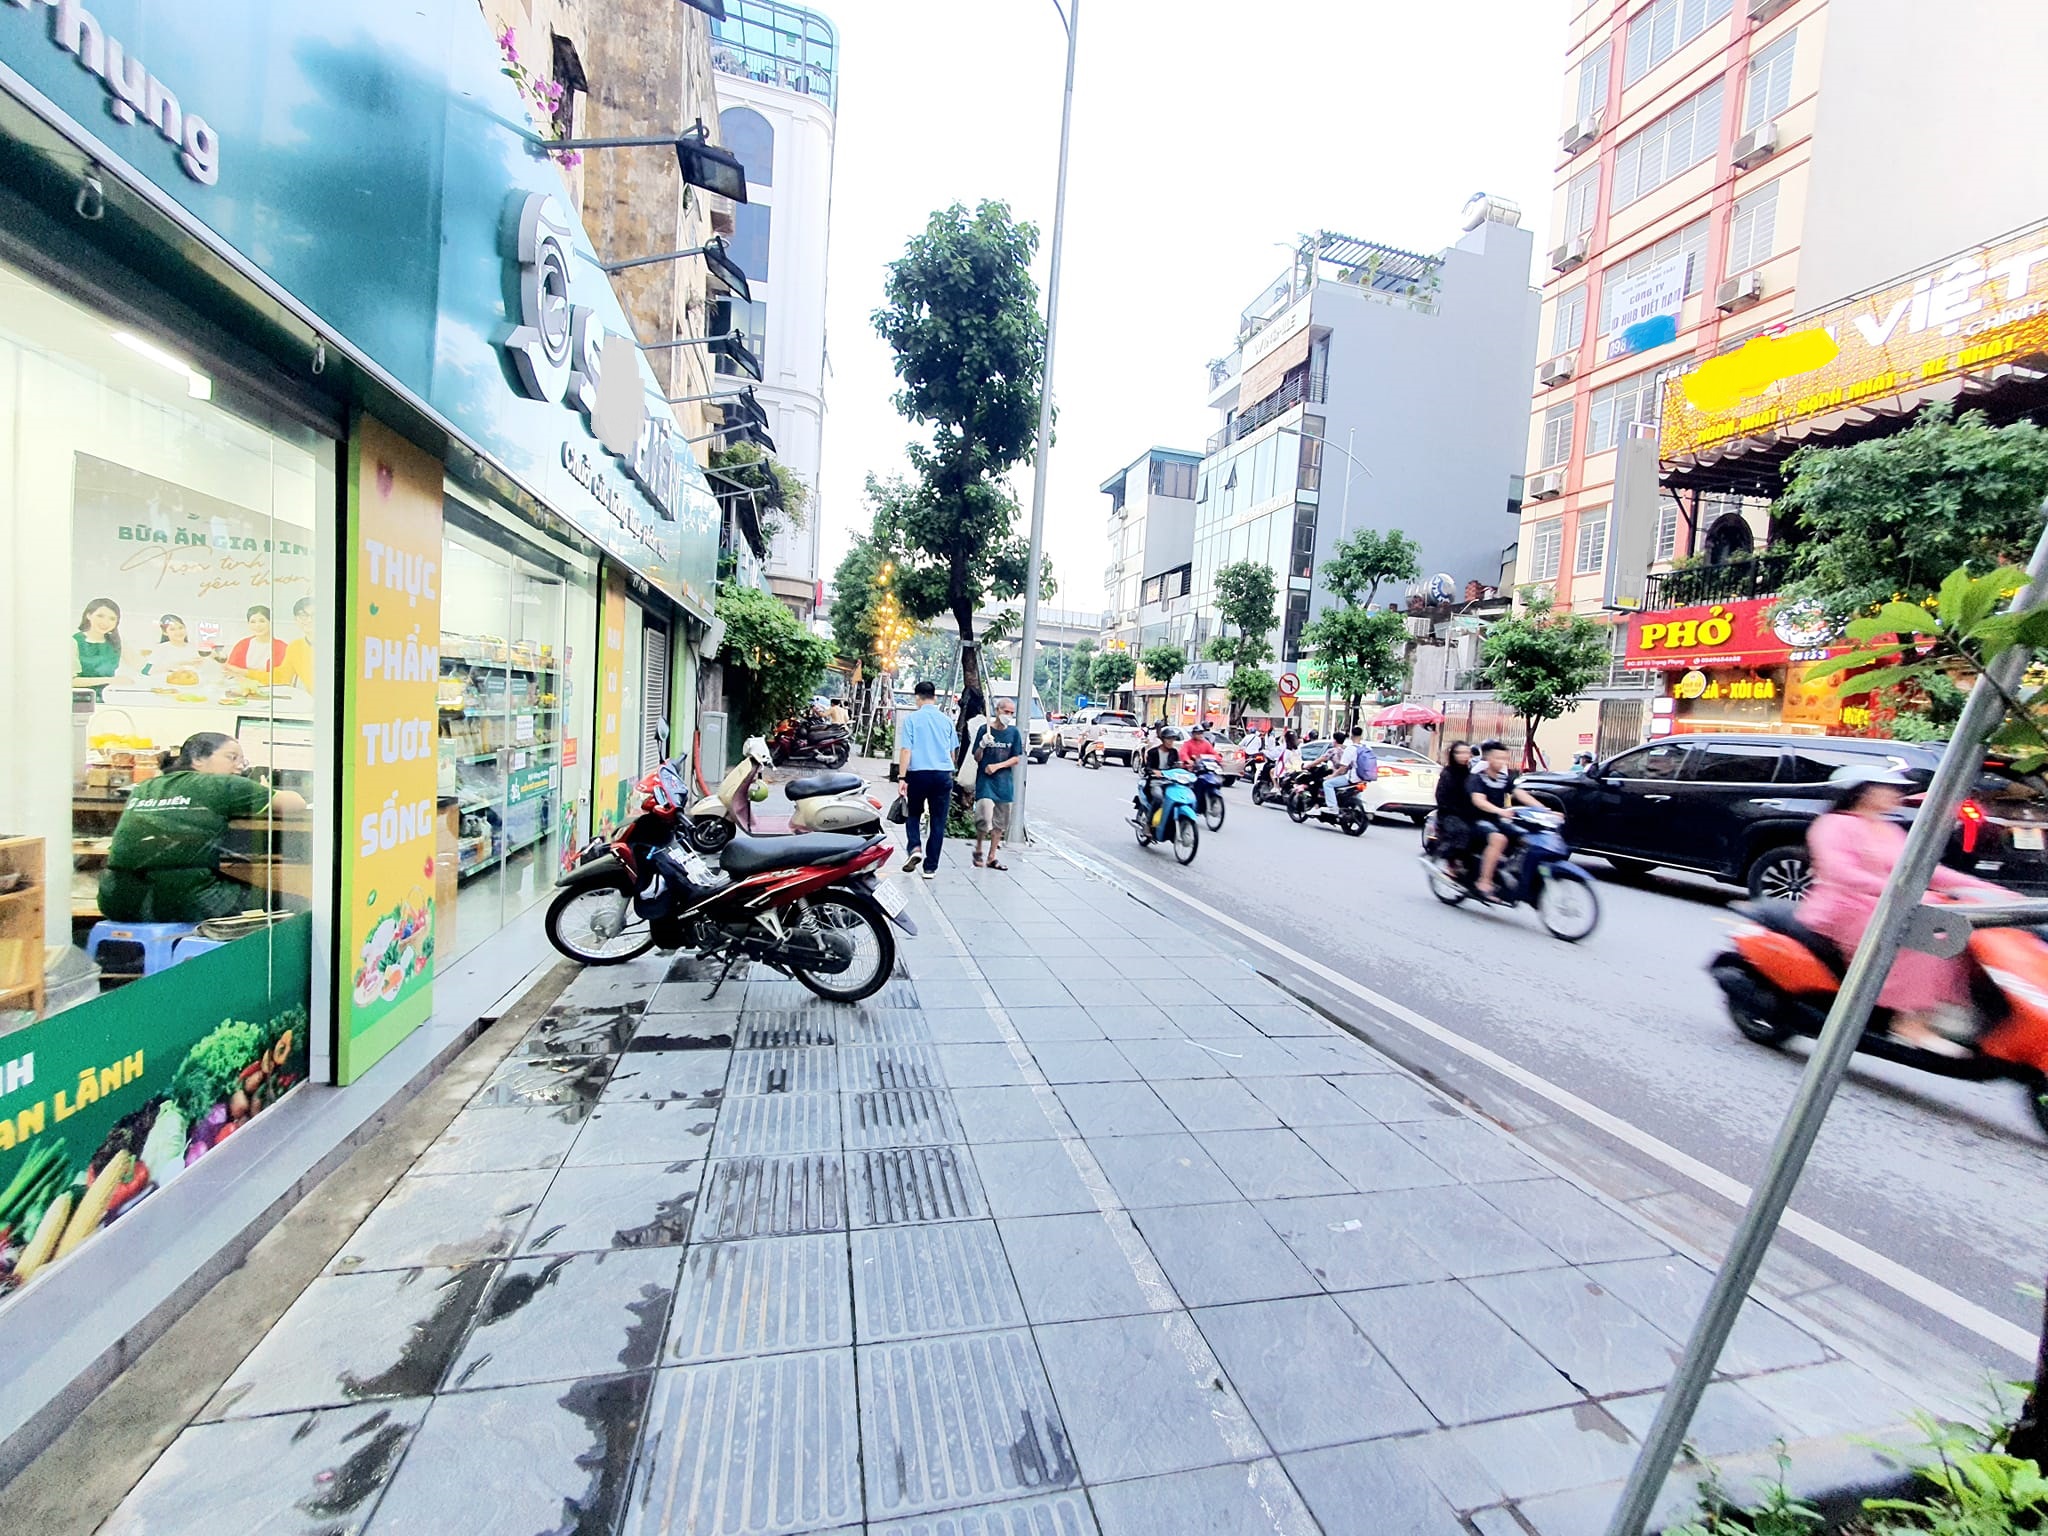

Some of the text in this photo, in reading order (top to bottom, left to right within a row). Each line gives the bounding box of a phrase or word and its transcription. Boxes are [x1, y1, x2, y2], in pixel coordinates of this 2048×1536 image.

[174, 527, 206, 546] ĂN
[365, 537, 437, 608] THỰC
[364, 623, 439, 683] PHẨM
[1640, 605, 1735, 650] PHỞ
[362, 717, 432, 766] TƯƠI
[361, 789, 432, 858] SỐNG
